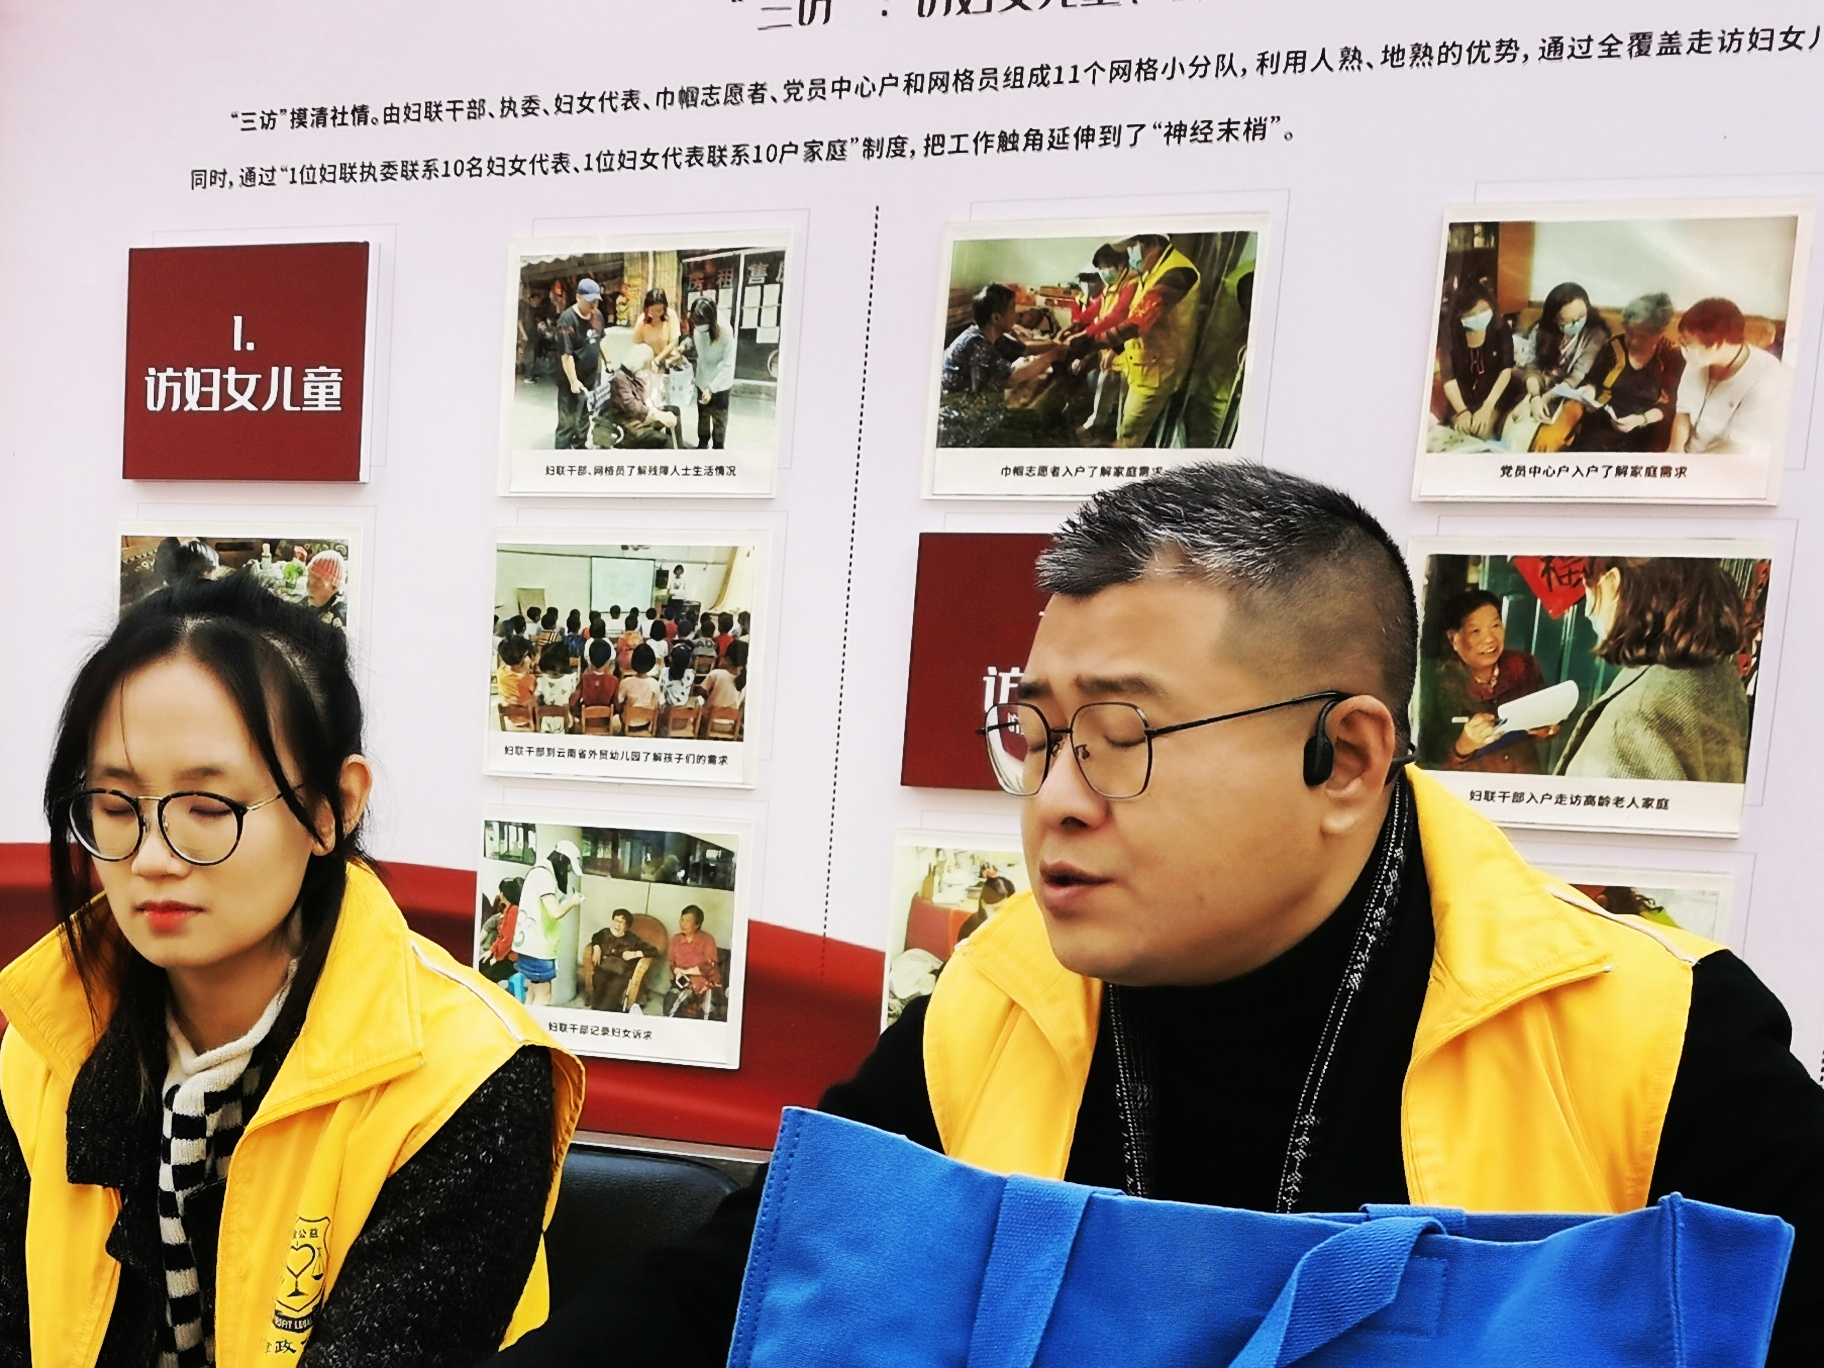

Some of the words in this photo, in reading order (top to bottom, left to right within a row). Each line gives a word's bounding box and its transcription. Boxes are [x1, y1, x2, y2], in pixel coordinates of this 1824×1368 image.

[144, 365, 343, 412] 访妇女儿童
[545, 464, 736, 477] 妇联干部、网格员了解残障人士生活情况
[1500, 465, 1688, 479] 党员中心户入户了解家庭需求
[1469, 788, 1670, 810] 妇联干部入户走访高龄老人家庭
[548, 1022, 653, 1041] 妇联干部记录妇女诉求
